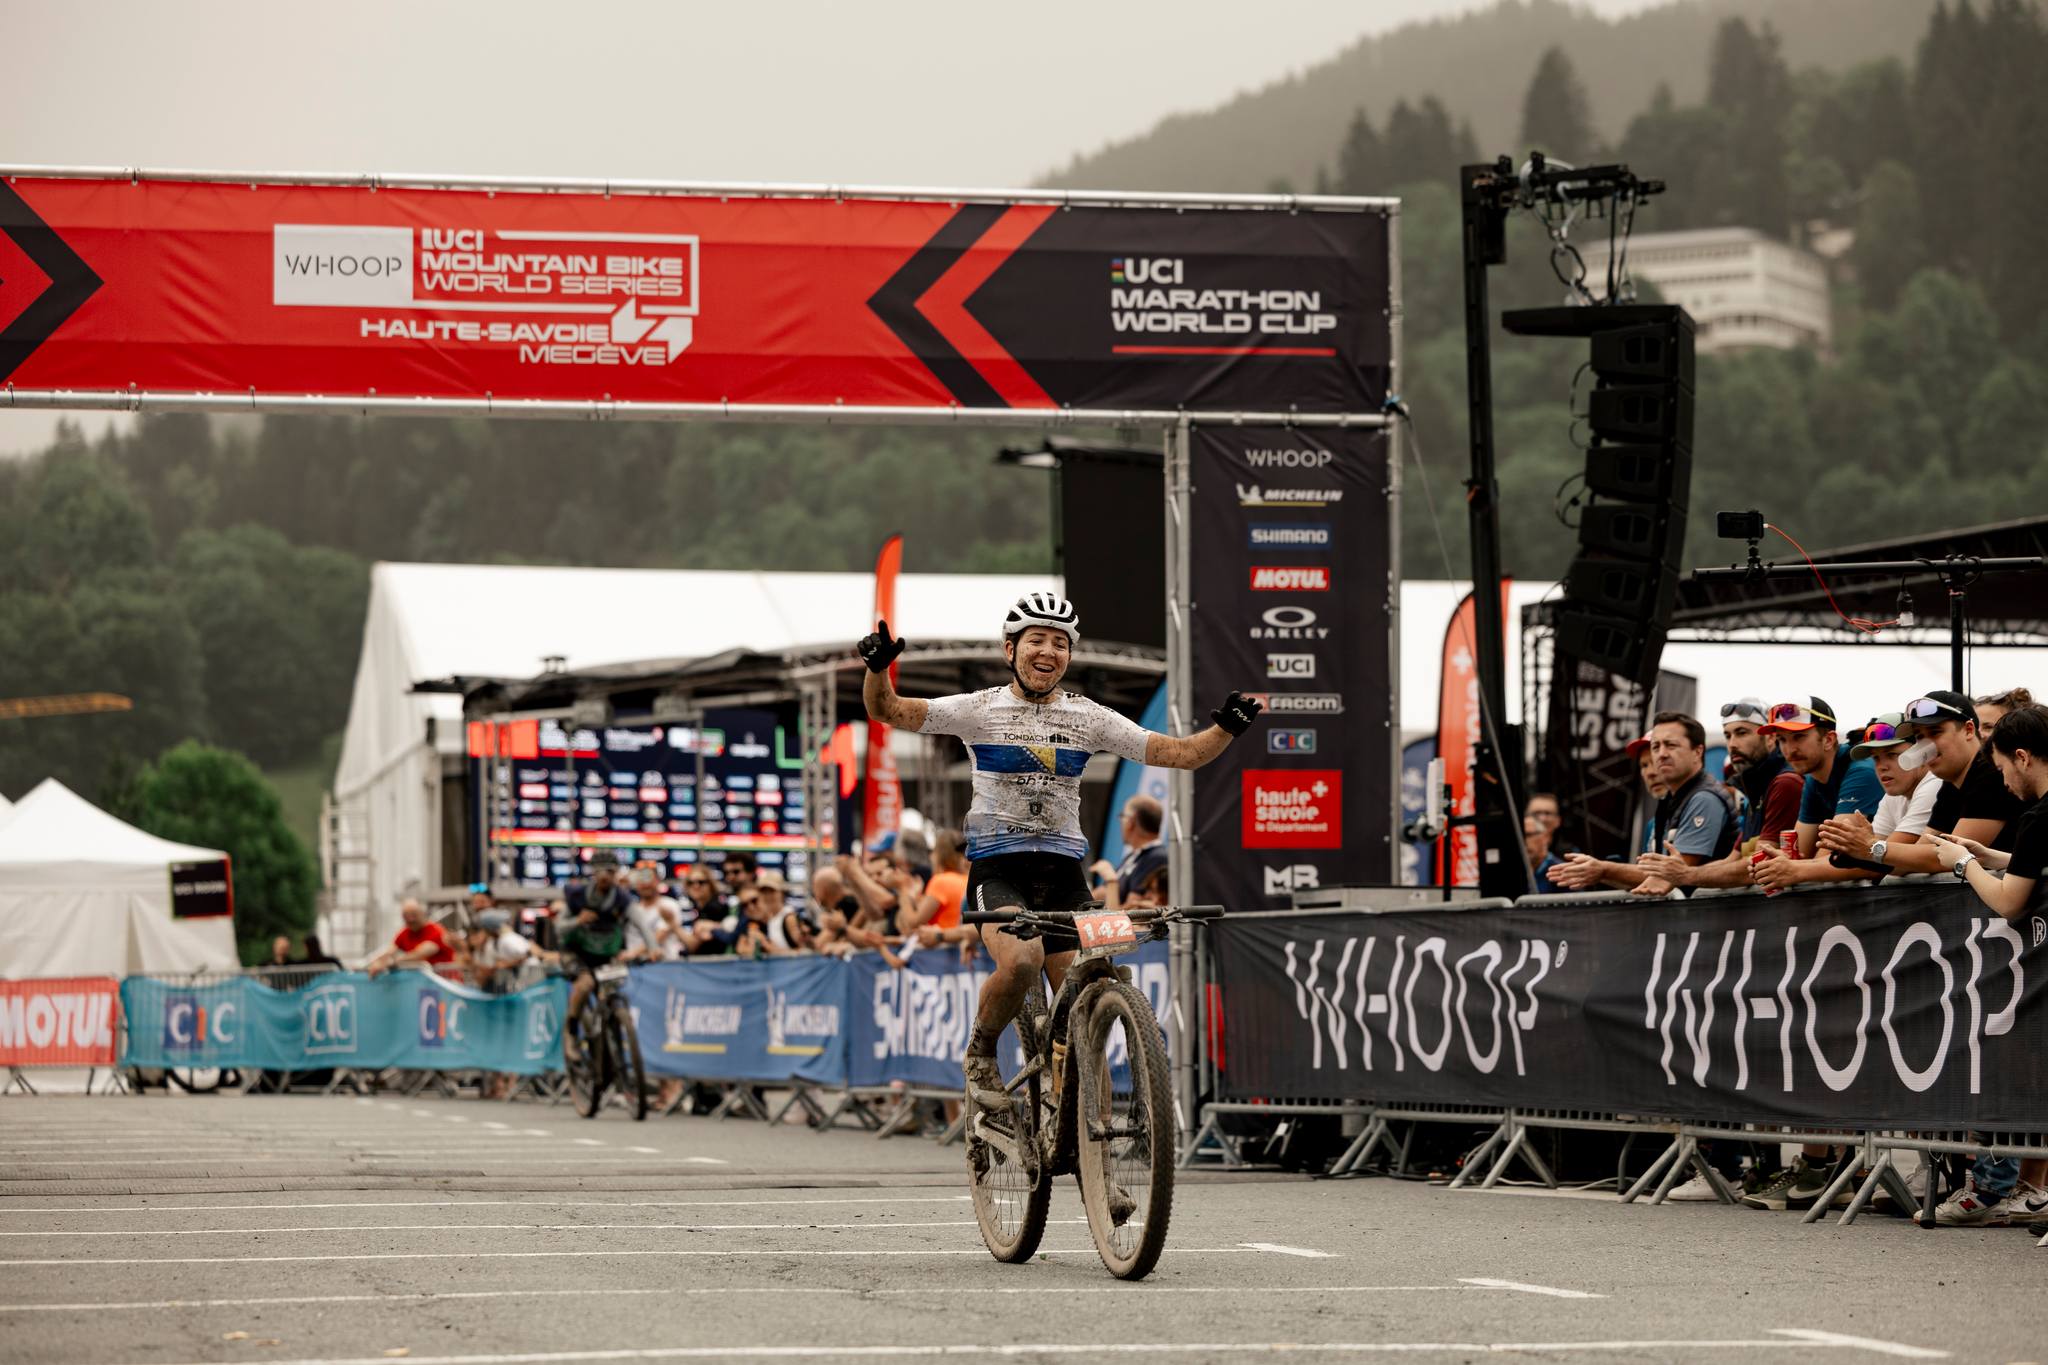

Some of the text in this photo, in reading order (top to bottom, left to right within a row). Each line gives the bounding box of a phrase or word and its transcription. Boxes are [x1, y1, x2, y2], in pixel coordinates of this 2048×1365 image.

[430, 229, 484, 251] UCI
[286, 255, 402, 278] WHOOP
[422, 253, 683, 277] MOUNTAIN BIKE
[1124, 258, 1184, 284] UCI
[422, 273, 683, 297] WORLD SERIES
[1111, 289, 1320, 311] MARATHON
[361, 319, 610, 343] HAUTE-SAVOIE
[1111, 312, 1337, 334] WORLD CUP
[1245, 449, 1332, 468] WHOOP
[1264, 489, 1343, 502] MICHELIN
[1251, 528, 1329, 544] SHIMANO
[1253, 569, 1328, 589] MOTUL
[1250, 627, 1330, 639] OAKLEY
[1276, 659, 1311, 673] UCI
[1003, 733, 1049, 742] TONDACH
[1272, 733, 1313, 750] CIC
[1255, 786, 1312, 806] haute
[1255, 806, 1320, 821] savoie
[1082, 920, 1133, 942] 142
[0, 992, 112, 1048] MOTUL
[168, 1002, 236, 1043] CIC
[310, 997, 351, 1041] CIC
[420, 996, 467, 1041] CIC
